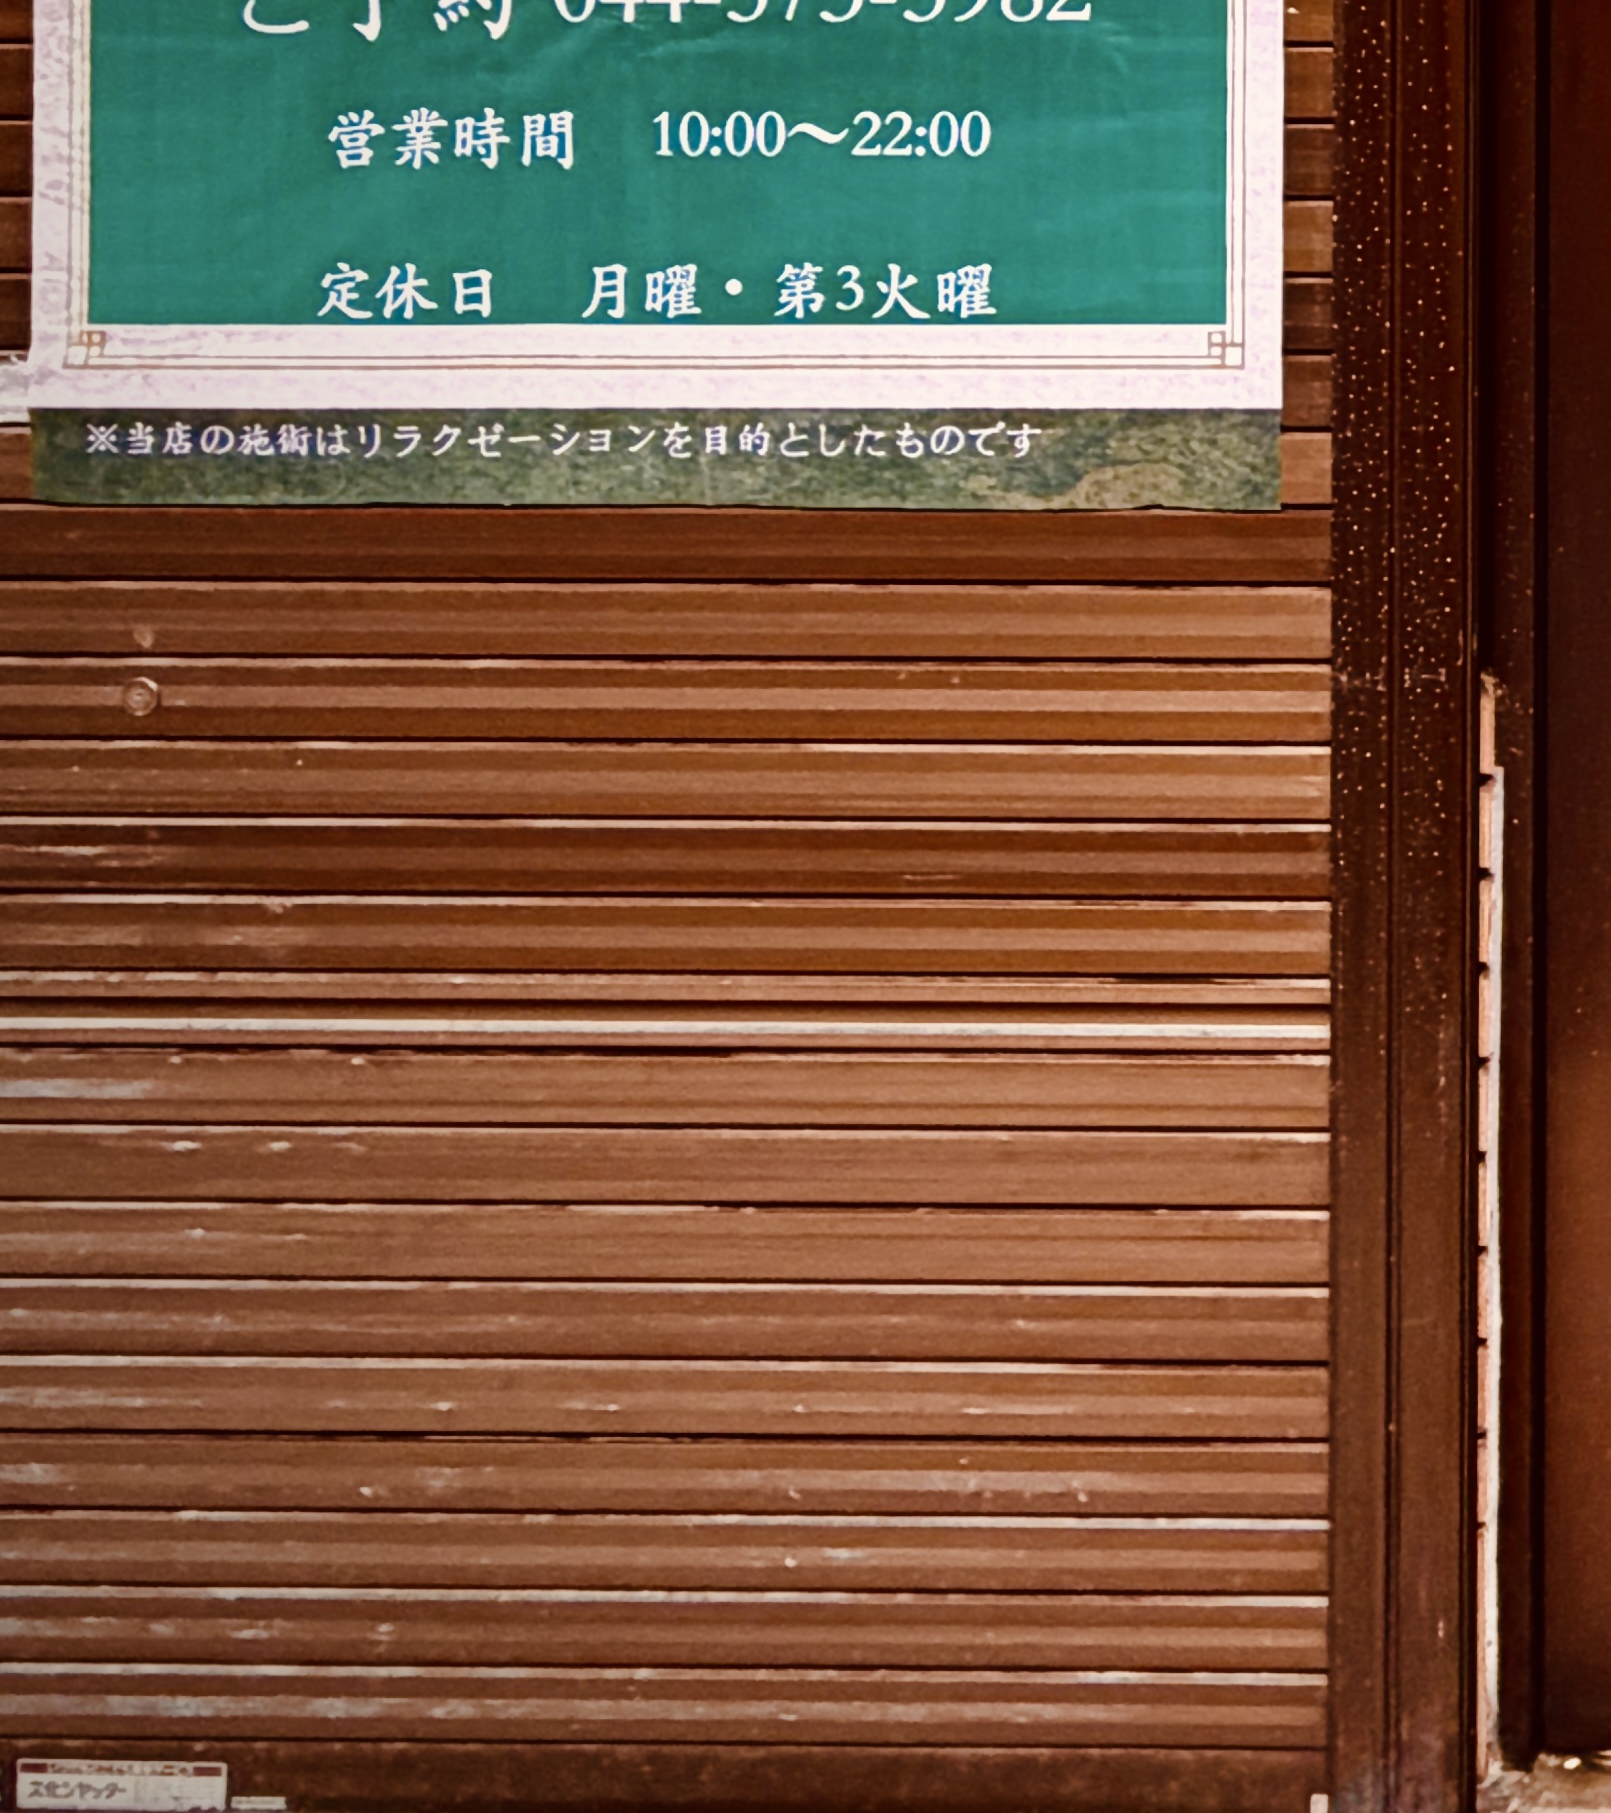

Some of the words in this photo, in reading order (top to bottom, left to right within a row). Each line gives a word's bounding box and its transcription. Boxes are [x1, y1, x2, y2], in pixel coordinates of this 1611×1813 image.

[328, 108, 575, 171] 営業時間
[653, 110, 993, 158] 10:00〜22:00
[318, 262, 495, 320] 定休日
[582, 262, 998, 320] 月曜・第3火曜
[87, 422, 1044, 459] ※当店の施術はリラクゼーションを目的としたものです
